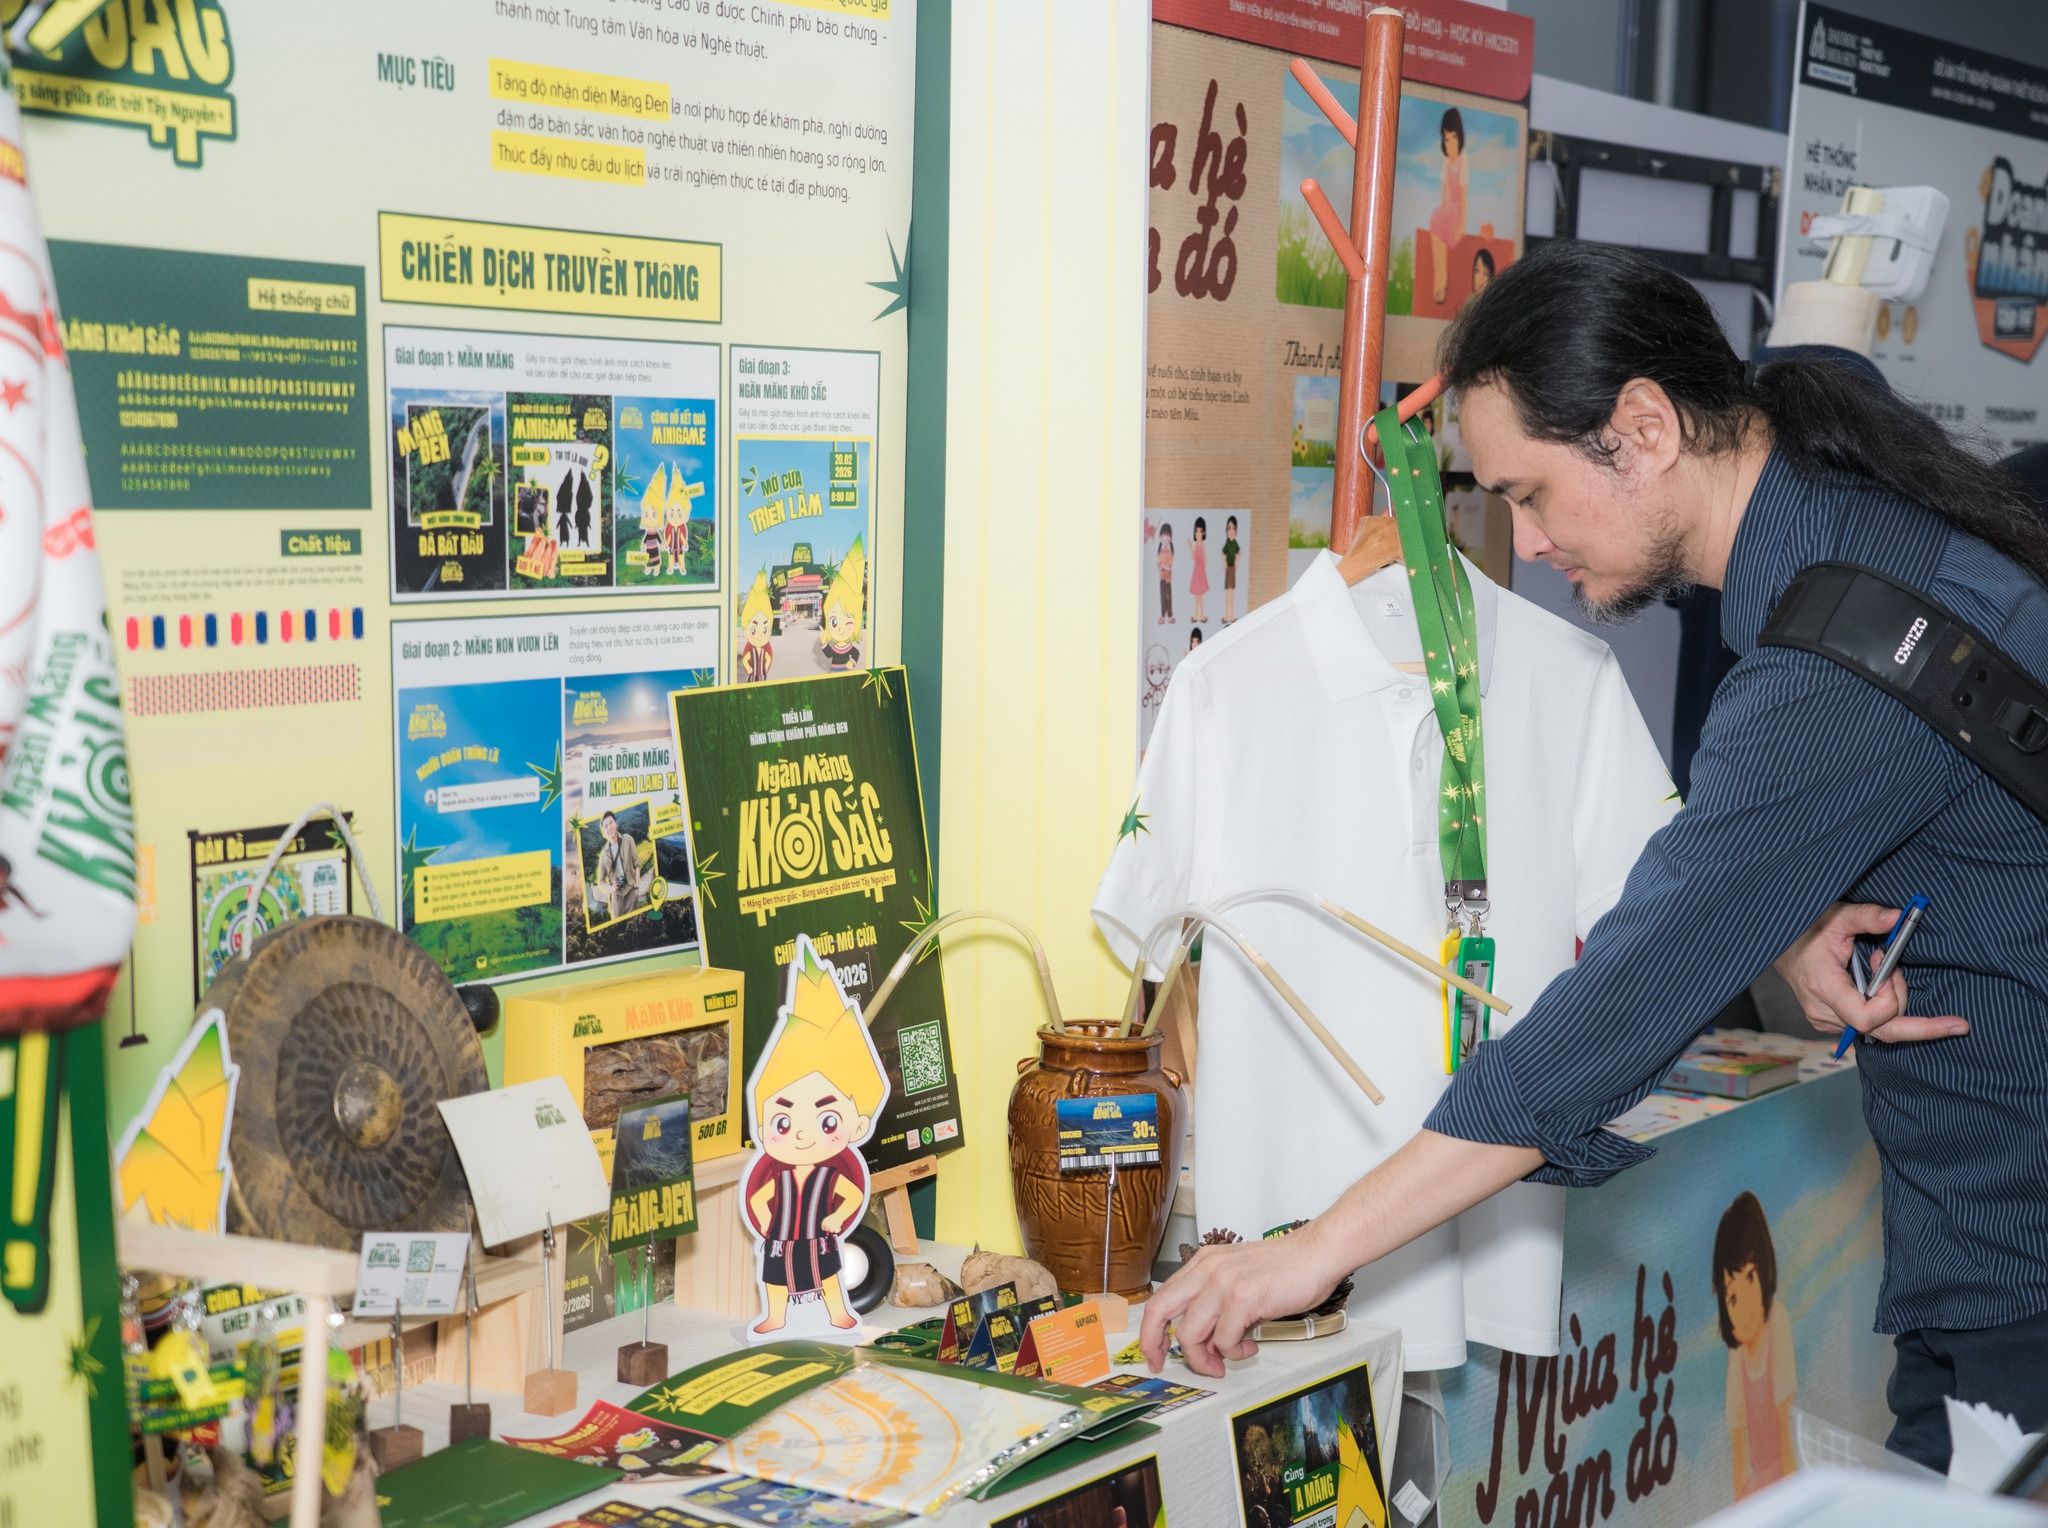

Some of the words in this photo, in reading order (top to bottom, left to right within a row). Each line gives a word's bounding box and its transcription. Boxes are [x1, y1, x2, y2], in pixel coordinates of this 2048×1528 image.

[377, 52, 416, 91] MỤC
[421, 56, 455, 92] TIÊU
[496, 72, 527, 97] Tăng
[530, 78, 546, 100] độ
[550, 80, 578, 104] nhận
[582, 86, 607, 106] diện
[610, 90, 642, 113] Măng
[645, 94, 668, 113] Đen
[671, 98, 681, 114] là
[684, 102, 701, 118] nơi
[705, 102, 726, 122] phù
[729, 106, 750, 127] hợp
[753, 108, 768, 126] để
[770, 111, 800, 130] khám
[828, 121, 852, 140] nghỉ
[854, 124, 888, 145] dưỡng
[497, 109, 525, 130] đậm
[528, 112, 544, 126] đà
[548, 114, 570, 134] bản
[574, 118, 594, 137] sắc
[598, 124, 618, 140] văn
[647, 130, 676, 152] nghệ
[679, 135, 708, 154] thuật
[712, 139, 724, 154] và
[728, 138, 754, 157] thiên
[758, 142, 786, 160] nhiên
[790, 146, 824, 168] hoang
[827, 154, 840, 167] sơ
[842, 154, 866, 174] rộng
[868, 156, 887, 173] lớn.
[1189, 78, 1247, 204] hè
[498, 144, 526, 164] Thúc
[530, 147, 551, 170] đẩy
[556, 152, 578, 170] nhu
[581, 154, 602, 174] cầu
[606, 158, 620, 176] du
[624, 160, 644, 180] lịch
[647, 163, 660, 179] và
[664, 164, 682, 182] trải
[686, 169, 727, 190] nghiệm
[730, 172, 754, 192] thực
[757, 173, 768, 191] tế
[771, 178, 784, 196] tại
[788, 180, 804, 198] địa
[808, 182, 851, 203] phương.
[1174, 205, 1239, 302] đó
[544, 248, 628, 297] TRUYỀN
[258, 288, 277, 310] Hệ
[281, 288, 322, 312] thống
[326, 294, 350, 310] chữ
[106, 319, 146, 354] KHỞI
[146, 319, 181, 357] SẮC
[396, 348, 414, 365] Giai
[418, 349, 445, 371] đoạn
[458, 344, 483, 368] MẦM
[486, 348, 514, 370] MĂNG
[740, 358, 756, 374] Giai
[758, 360, 780, 378] đoạn
[782, 360, 790, 375] 3:
[1284, 341, 1323, 368] Thành
[739, 380, 761, 399] NGÀN
[764, 381, 788, 400] MĂNG
[791, 381, 809, 400] KHỞI
[811, 380, 827, 400] SẮC
[396, 409, 445, 457] MĂNG
[513, 417, 577, 440] MINIGAME
[652, 427, 706, 445] MINIGAME
[835, 454, 852, 465] 20.02
[835, 466, 852, 478] 2026
[761, 472, 779, 497] MỞ
[781, 467, 803, 490] CỬA
[846, 491, 855, 502] AM
[748, 498, 786, 536] TRIỂN
[788, 489, 824, 520] LÃM
[288, 534, 322, 553] Chất
[325, 535, 352, 556] liệu
[402, 642, 421, 660] Giai
[425, 642, 450, 662] đoạn
[466, 634, 493, 657] MĂNG
[496, 636, 514, 654] NON
[517, 634, 540, 653] VƯƠN
[543, 631, 559, 651] LÊN
[1894, 616, 1928, 665] OZUKO
[782, 707, 798, 725] TRIỂN
[799, 709, 813, 722] LÃM
[750, 732, 767, 746] HÀNH
[768, 728, 785, 743] TRÌNH
[786, 726, 804, 741] KHÁM
[804, 722, 817, 738] PHÁ
[818, 722, 835, 736] MĂNG
[836, 721, 848, 733] ĐEN
[589, 753, 612, 773] CÙNG
[616, 747, 639, 770] ĐỒNG
[643, 747, 669, 767] MĂNG
[757, 758, 801, 794] Ngàn
[803, 752, 854, 785] Măng
[589, 780, 607, 798] ANH
[610, 775, 637, 796] KHOAI
[640, 773, 663, 793] LANG
[737, 789, 829, 891] KHỞI
[824, 782, 893, 871] SẮC
[837, 925, 855, 951] MỞ
[856, 921, 877, 947] CỬA
[624, 1002, 666, 1031] MĂNG
[698, 1124, 715, 1141] 500
[716, 1119, 727, 1136] GR
[1133, 1121, 1156, 1139] 30%
[1630, 1263, 1678, 1392] hè
[1626, 1378, 1678, 1503] đó
[1284, 1467, 1304, 1483] Cùng
[1295, 1488, 1304, 1512] A
[1304, 1473, 1335, 1507] MĂNG
